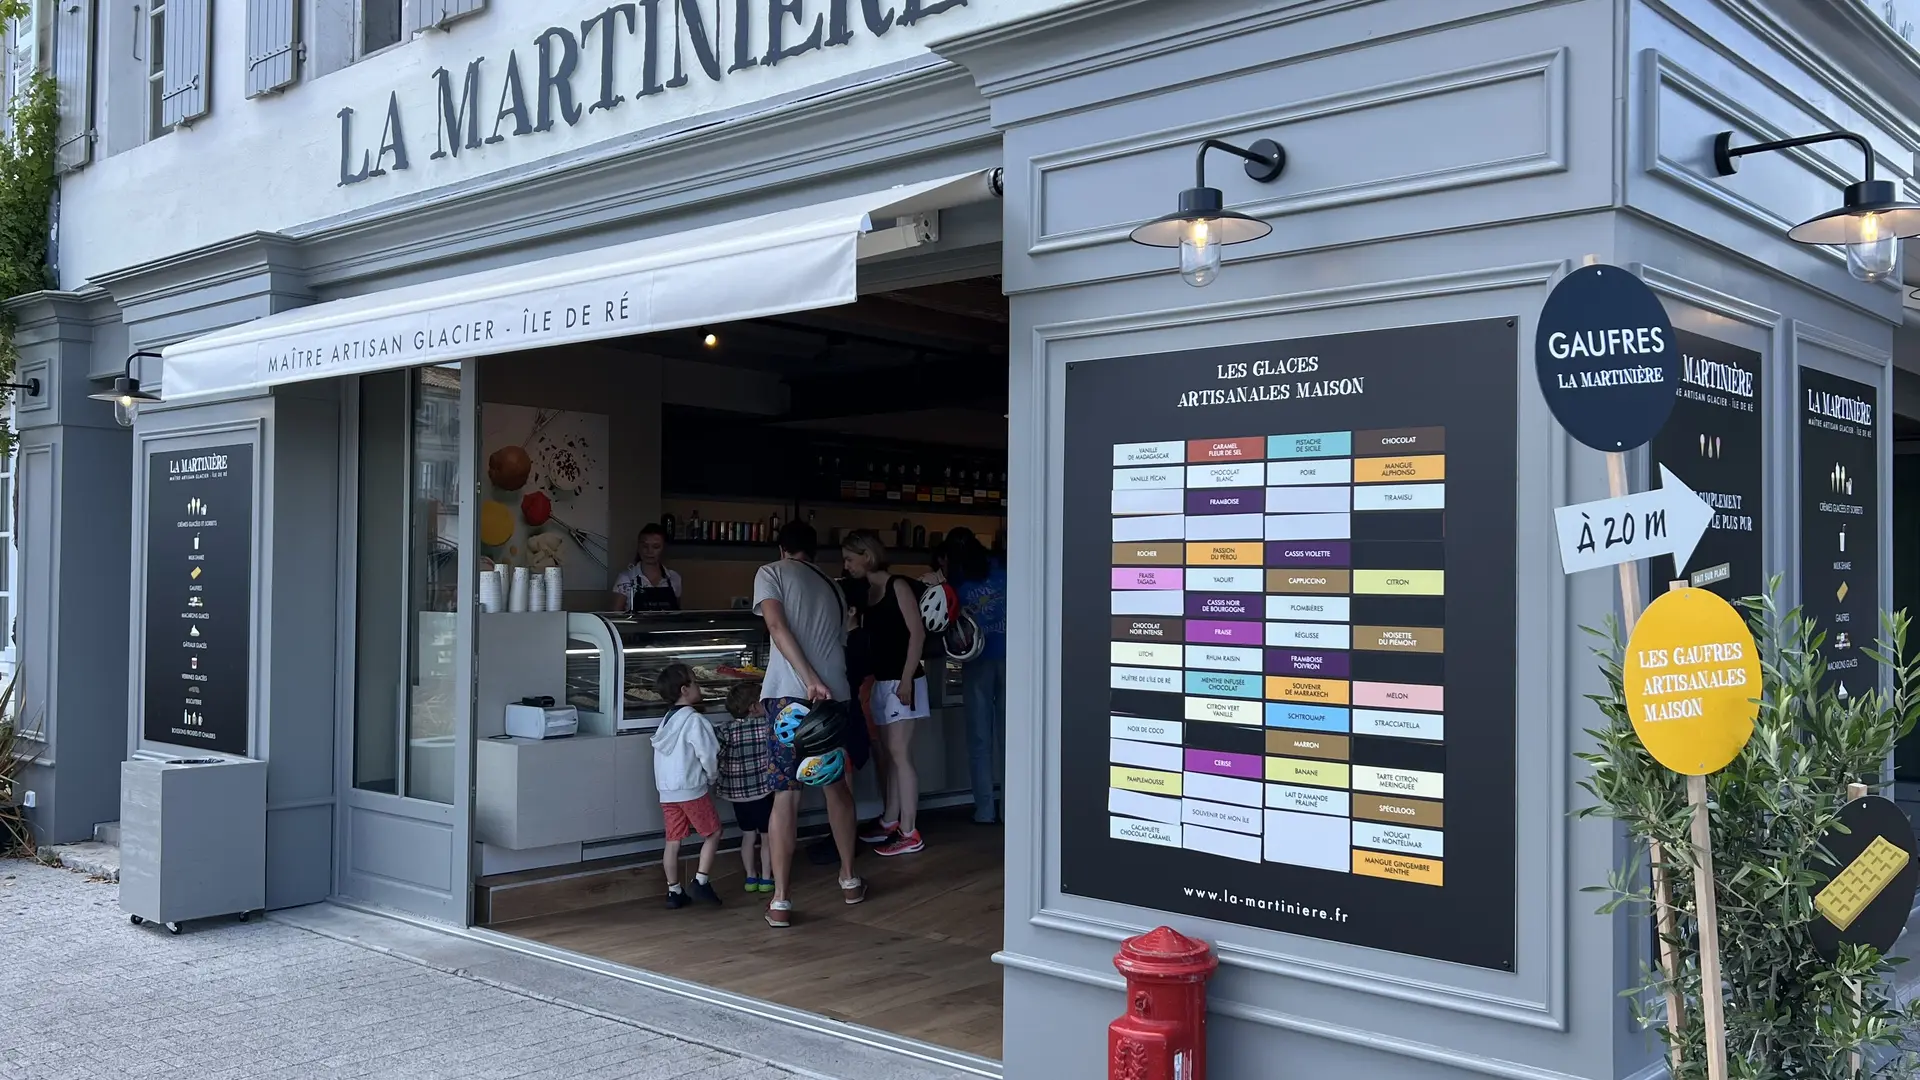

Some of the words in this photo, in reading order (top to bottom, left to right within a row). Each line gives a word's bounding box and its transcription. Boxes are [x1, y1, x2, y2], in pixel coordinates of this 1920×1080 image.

[337, 91, 409, 187] LA
[431, 0, 968, 160] MARTINI
[268, 347, 322, 373] MAÎTRE
[331, 335, 402, 371] ARTISAN
[413, 319, 495, 350] GLACIER
[522, 307, 552, 334] ÎLE
[565, 304, 591, 329] DE
[605, 291, 630, 323] RÉ
[1548, 326, 1665, 359] GAUFRES
[1217, 363, 1247, 379] LES
[1252, 356, 1319, 377] GLACES
[1682, 354, 1753, 397] MARTINIÈRE
[1558, 372, 1578, 389] LA
[1580, 364, 1664, 388] MARTINIÈRE
[1177, 384, 1290, 407] ARTISANALES
[1296, 377, 1365, 399] MAISON
[1684, 389, 1706, 402] ARTISAN
[1706, 394, 1728, 407] GLACIER
[1731, 398, 1739, 409] ÎLE
[1740, 402, 1747, 411] DE
[1747, 402, 1754, 412] RÉ
[1808, 388, 1820, 414] LA
[1822, 391, 1872, 426] MARTINIÈRE
[170, 460, 180, 473] LA
[181, 452, 228, 472] MARTINIÈRE
[1711, 515, 1720, 529] LE
[1722, 515, 1738, 530] PLUS
[1740, 516, 1752, 531] PUR
[1577, 512, 1595, 554] À
[1604, 512, 1635, 549] 20
[1694, 574, 1704, 584] FAIT
[1705, 571, 1714, 581] SUR
[1714, 567, 1727, 579] PLACE
[1295, 631, 1319, 639] RÉGLISSE
[1291, 655, 1323, 663] FRAMBOISE
[1638, 649, 1668, 668] LES
[1673, 642, 1742, 666] GAUFRES
[1642, 668, 1746, 696] ARTISANALES
[1294, 690, 1328, 698] MARRAKECH
[1288, 713, 1326, 721] SCHTROUMPF
[1644, 697, 1703, 722] MAISON
[1375, 720, 1420, 729] STRACCIATELLA
[1294, 741, 1319, 749] MARRON
[1127, 776, 1164, 785] PAMPLEMOUSSE
[1295, 768, 1318, 776] BANANE
[1395, 774, 1418, 783] CITRON
[1192, 809, 1218, 819] SOUVENIR
[1120, 829, 1147, 838] CHOCOLAT
[1148, 833, 1171, 841] CARAMEL
[1384, 831, 1410, 839] NOUGAT
[1365, 857, 1392, 866] MANGUE
[1393, 861, 1430, 871] GINGEMBRE
[1384, 867, 1409, 875] MENTHE
[1183, 886, 1349, 922] www.la-martiniere.fr
